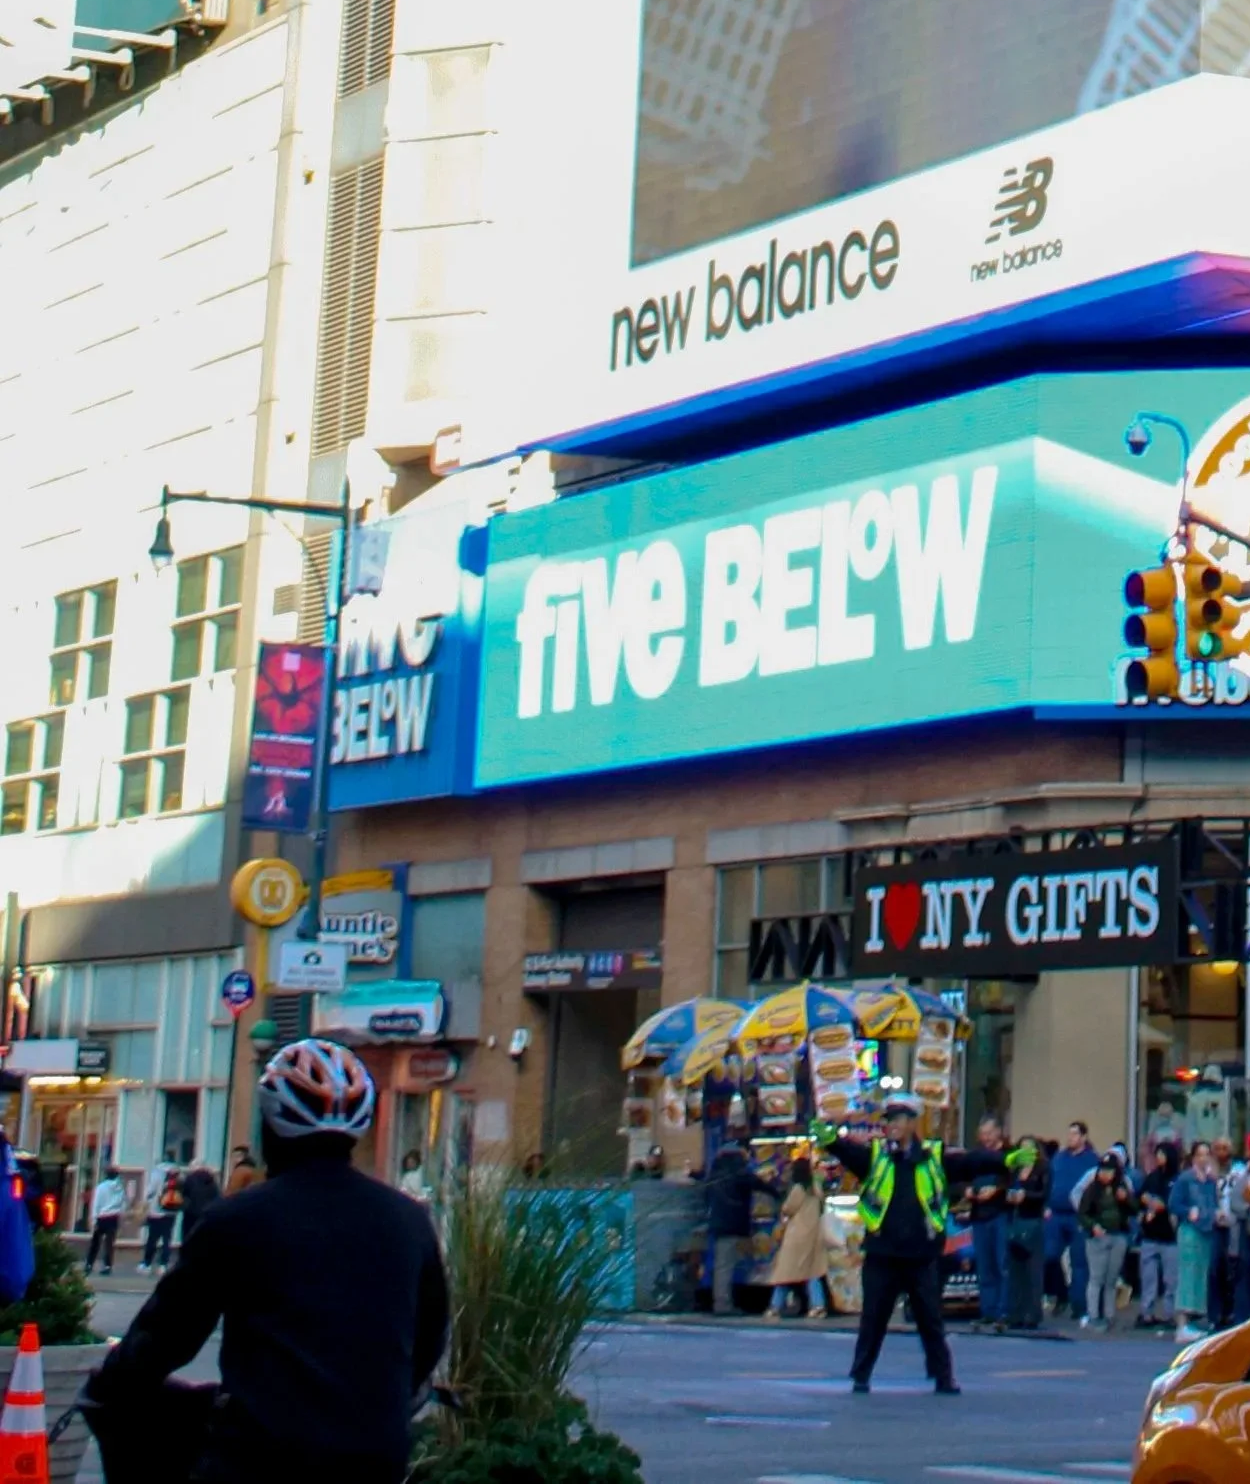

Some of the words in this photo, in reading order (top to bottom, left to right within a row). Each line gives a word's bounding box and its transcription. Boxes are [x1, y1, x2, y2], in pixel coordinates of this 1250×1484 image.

[610, 285, 697, 371] new
[705, 219, 901, 342] balance
[970, 258, 998, 282] new
[1003, 238, 1063, 273] balance
[516, 540, 687, 720] five
[324, 911, 397, 937] untie
[865, 885, 886, 954] I
[1005, 863, 1161, 946] GIFTS
